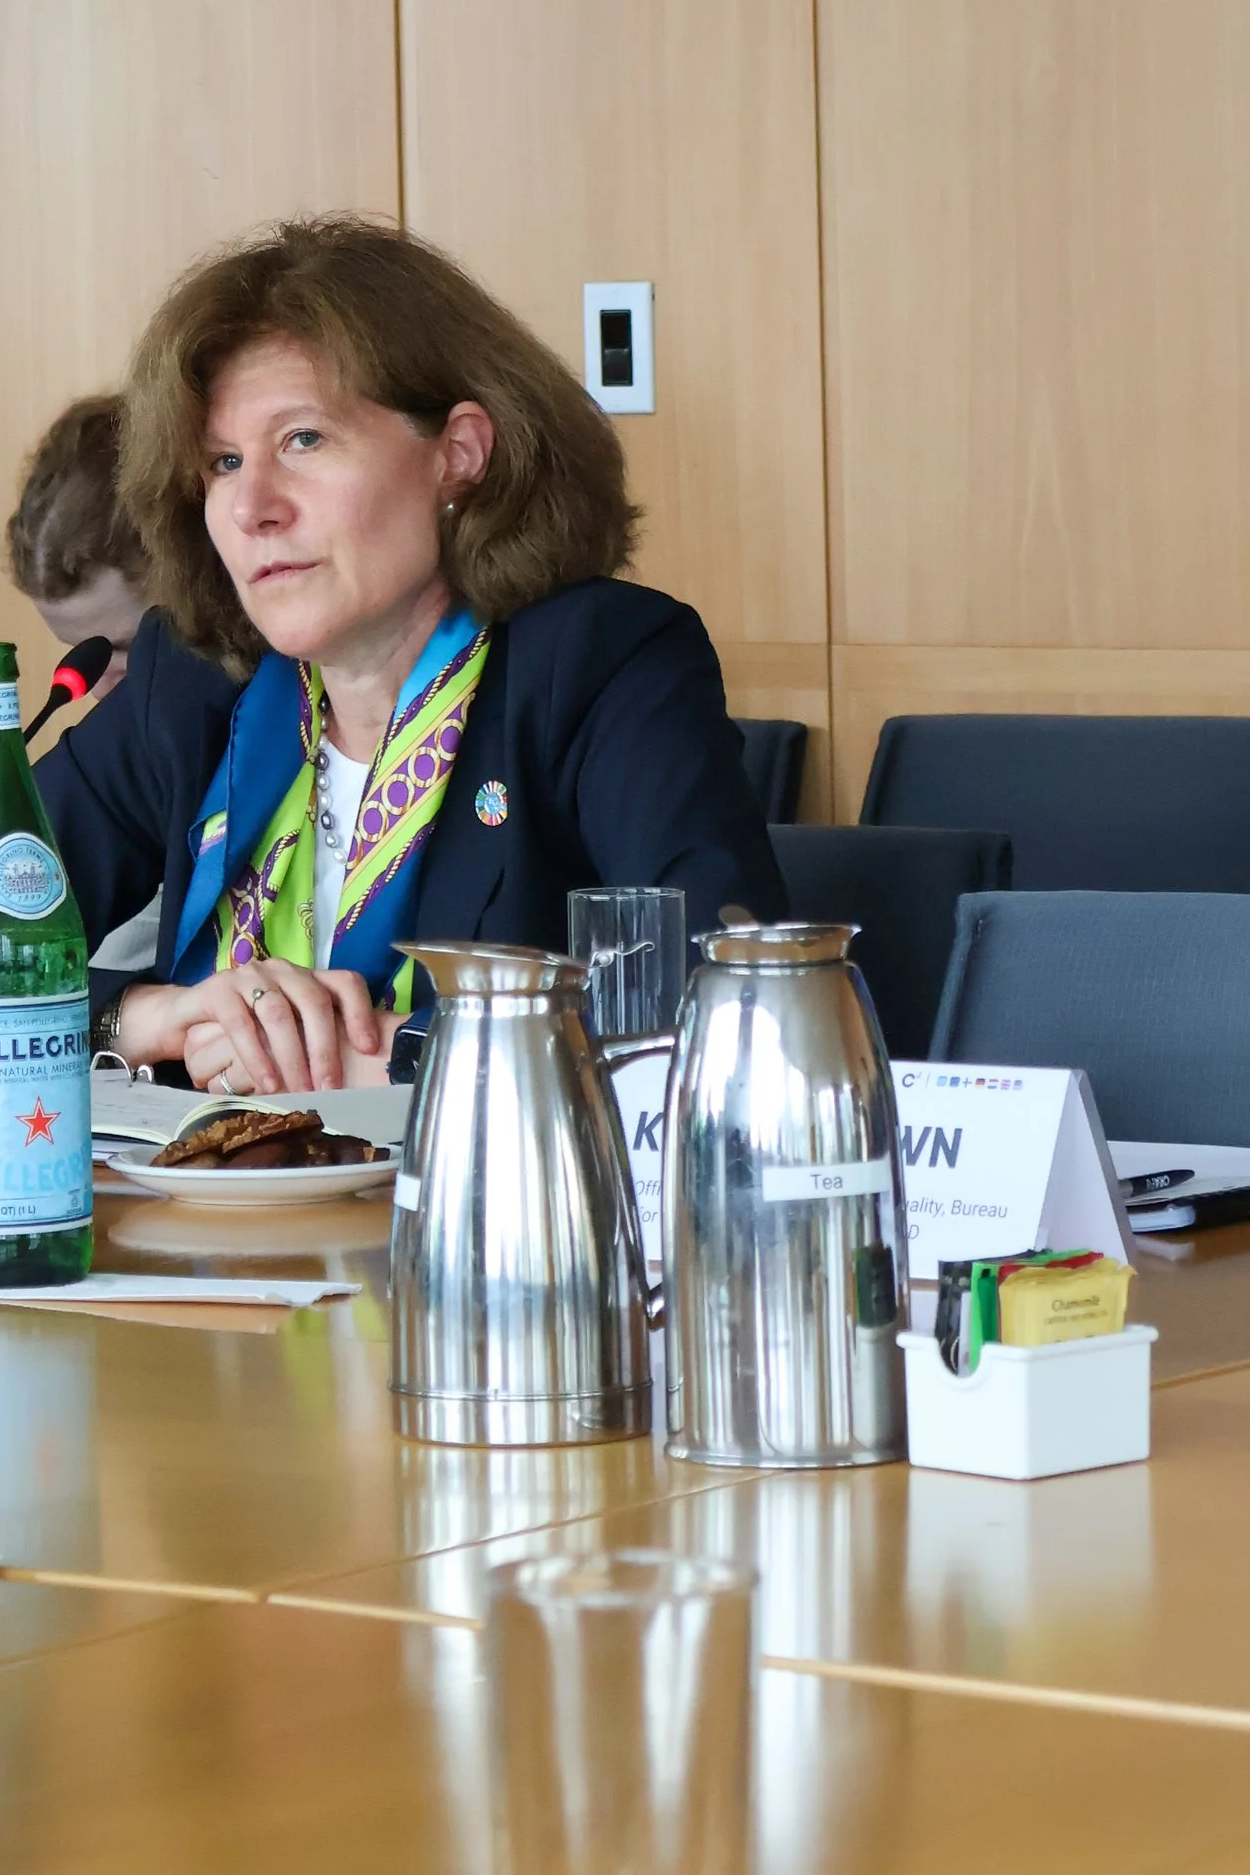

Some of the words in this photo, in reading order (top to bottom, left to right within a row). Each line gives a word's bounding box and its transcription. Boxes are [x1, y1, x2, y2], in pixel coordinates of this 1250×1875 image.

[0, 1066, 47, 1076] NATURAL
[901, 1125, 963, 1168] WN
[810, 1174, 843, 1190] Tea
[0, 1206, 16, 1217] QT)
[951, 1199, 1008, 1218] Bureau
